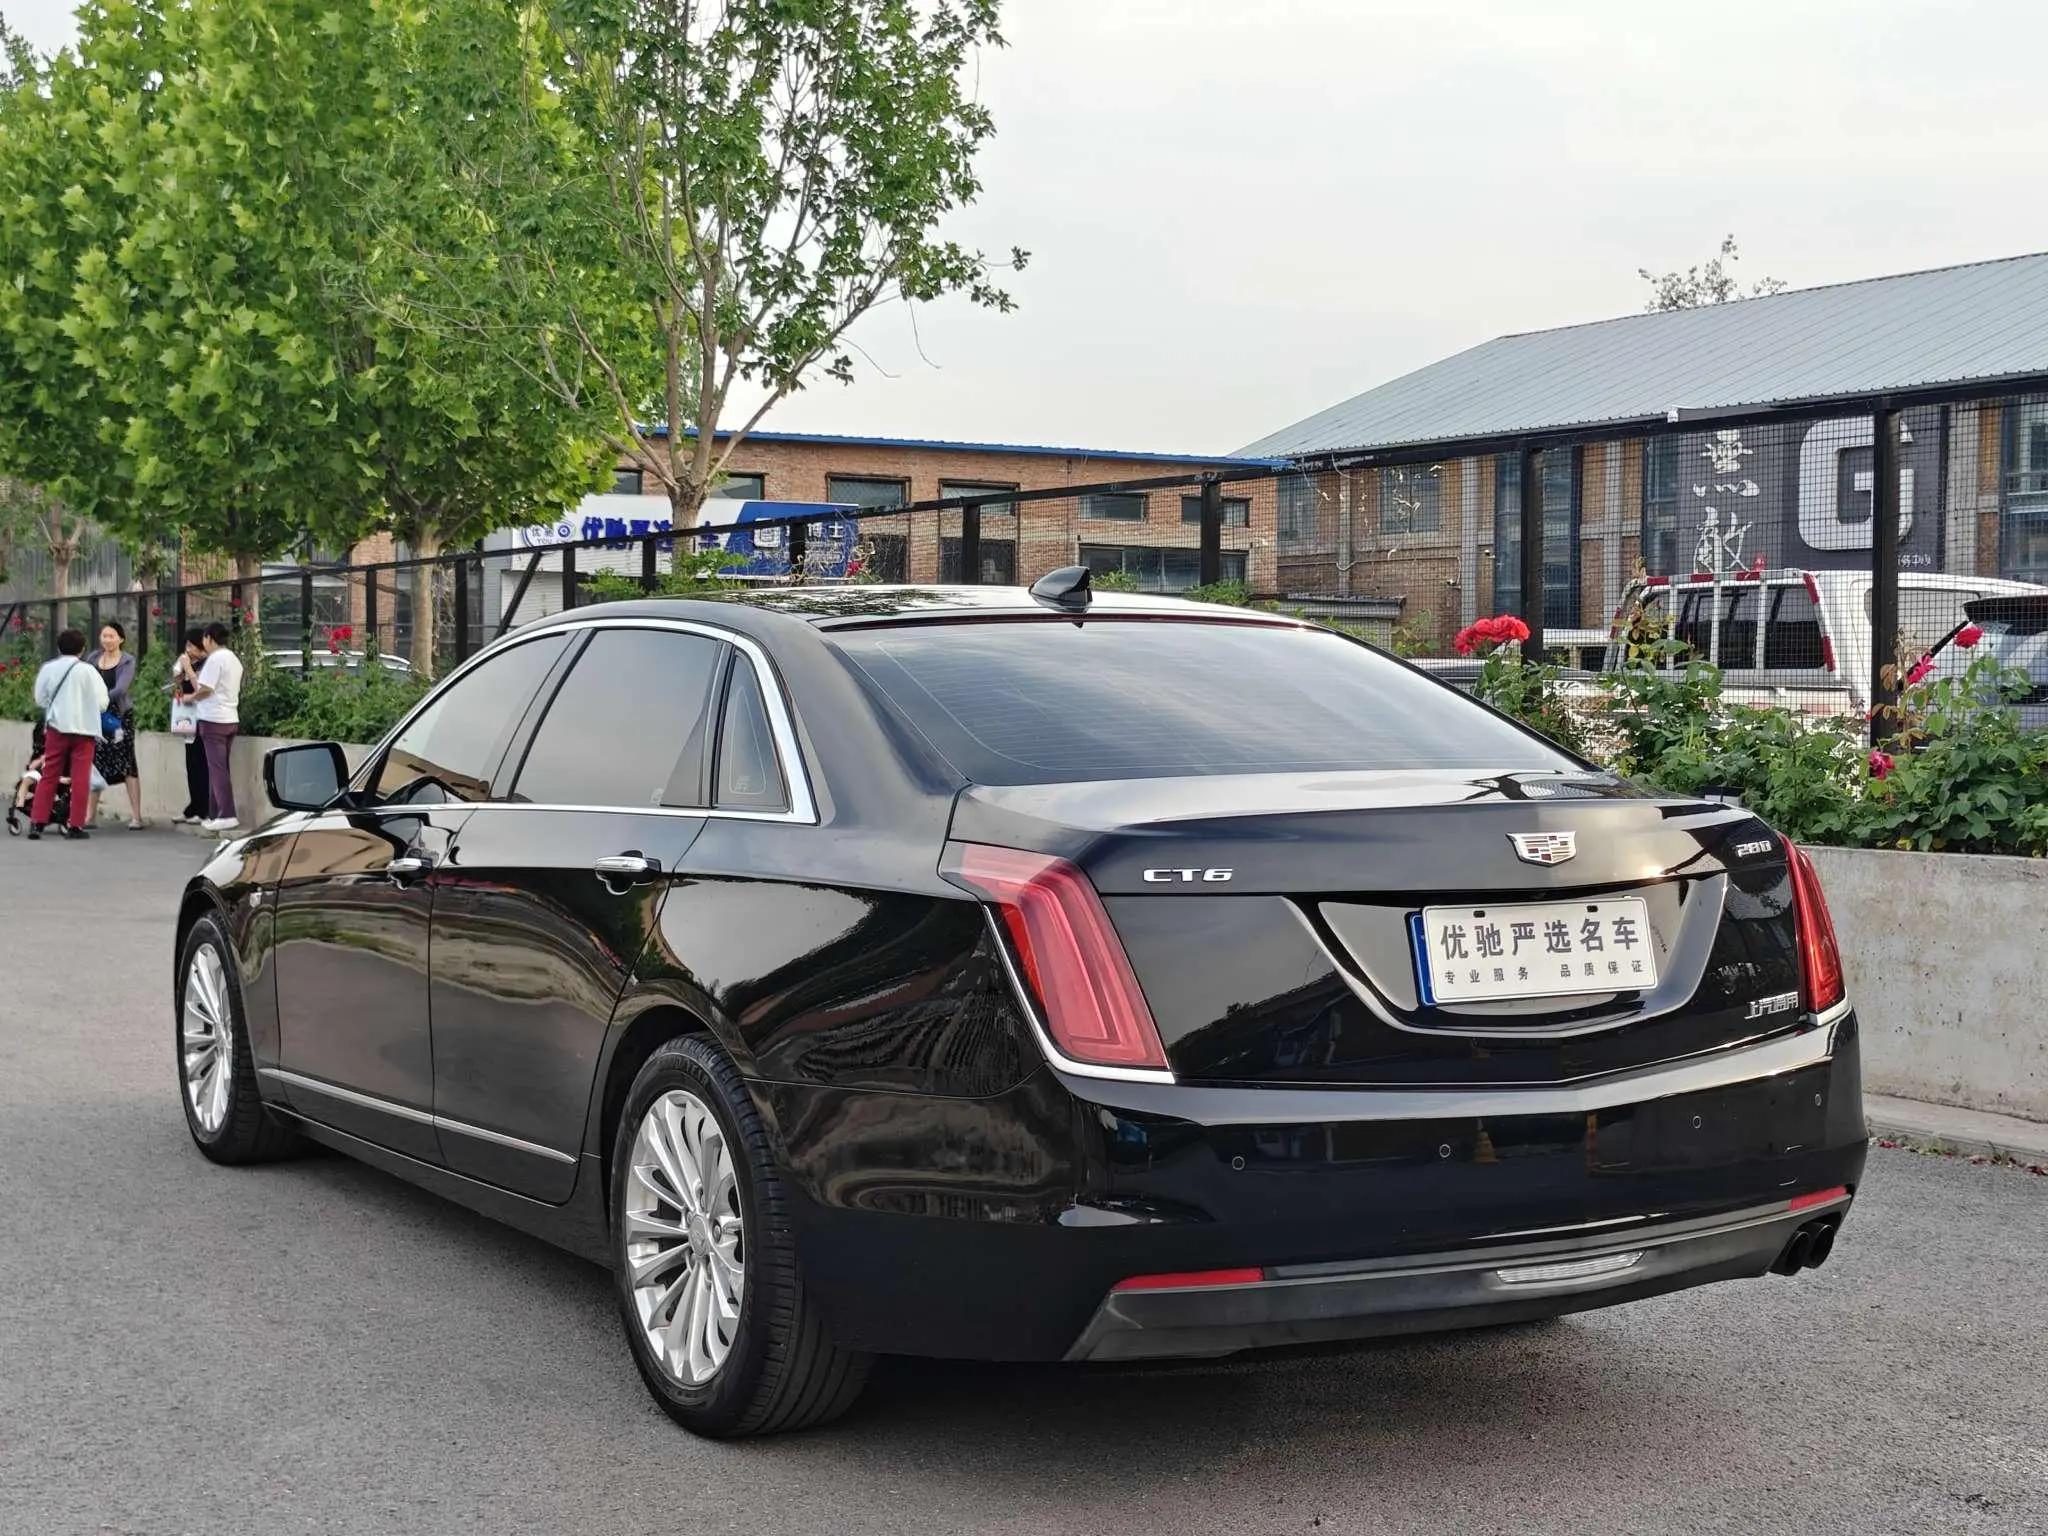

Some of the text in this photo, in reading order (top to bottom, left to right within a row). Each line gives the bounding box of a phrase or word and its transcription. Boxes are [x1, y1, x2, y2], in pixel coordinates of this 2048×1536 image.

[1897, 554, 1931, 567] 务中心
[1143, 868, 1234, 882] CT6
[1440, 916, 1639, 961] 优驰严选名车
[1444, 959, 1643, 985] 专业服务 品质保证
